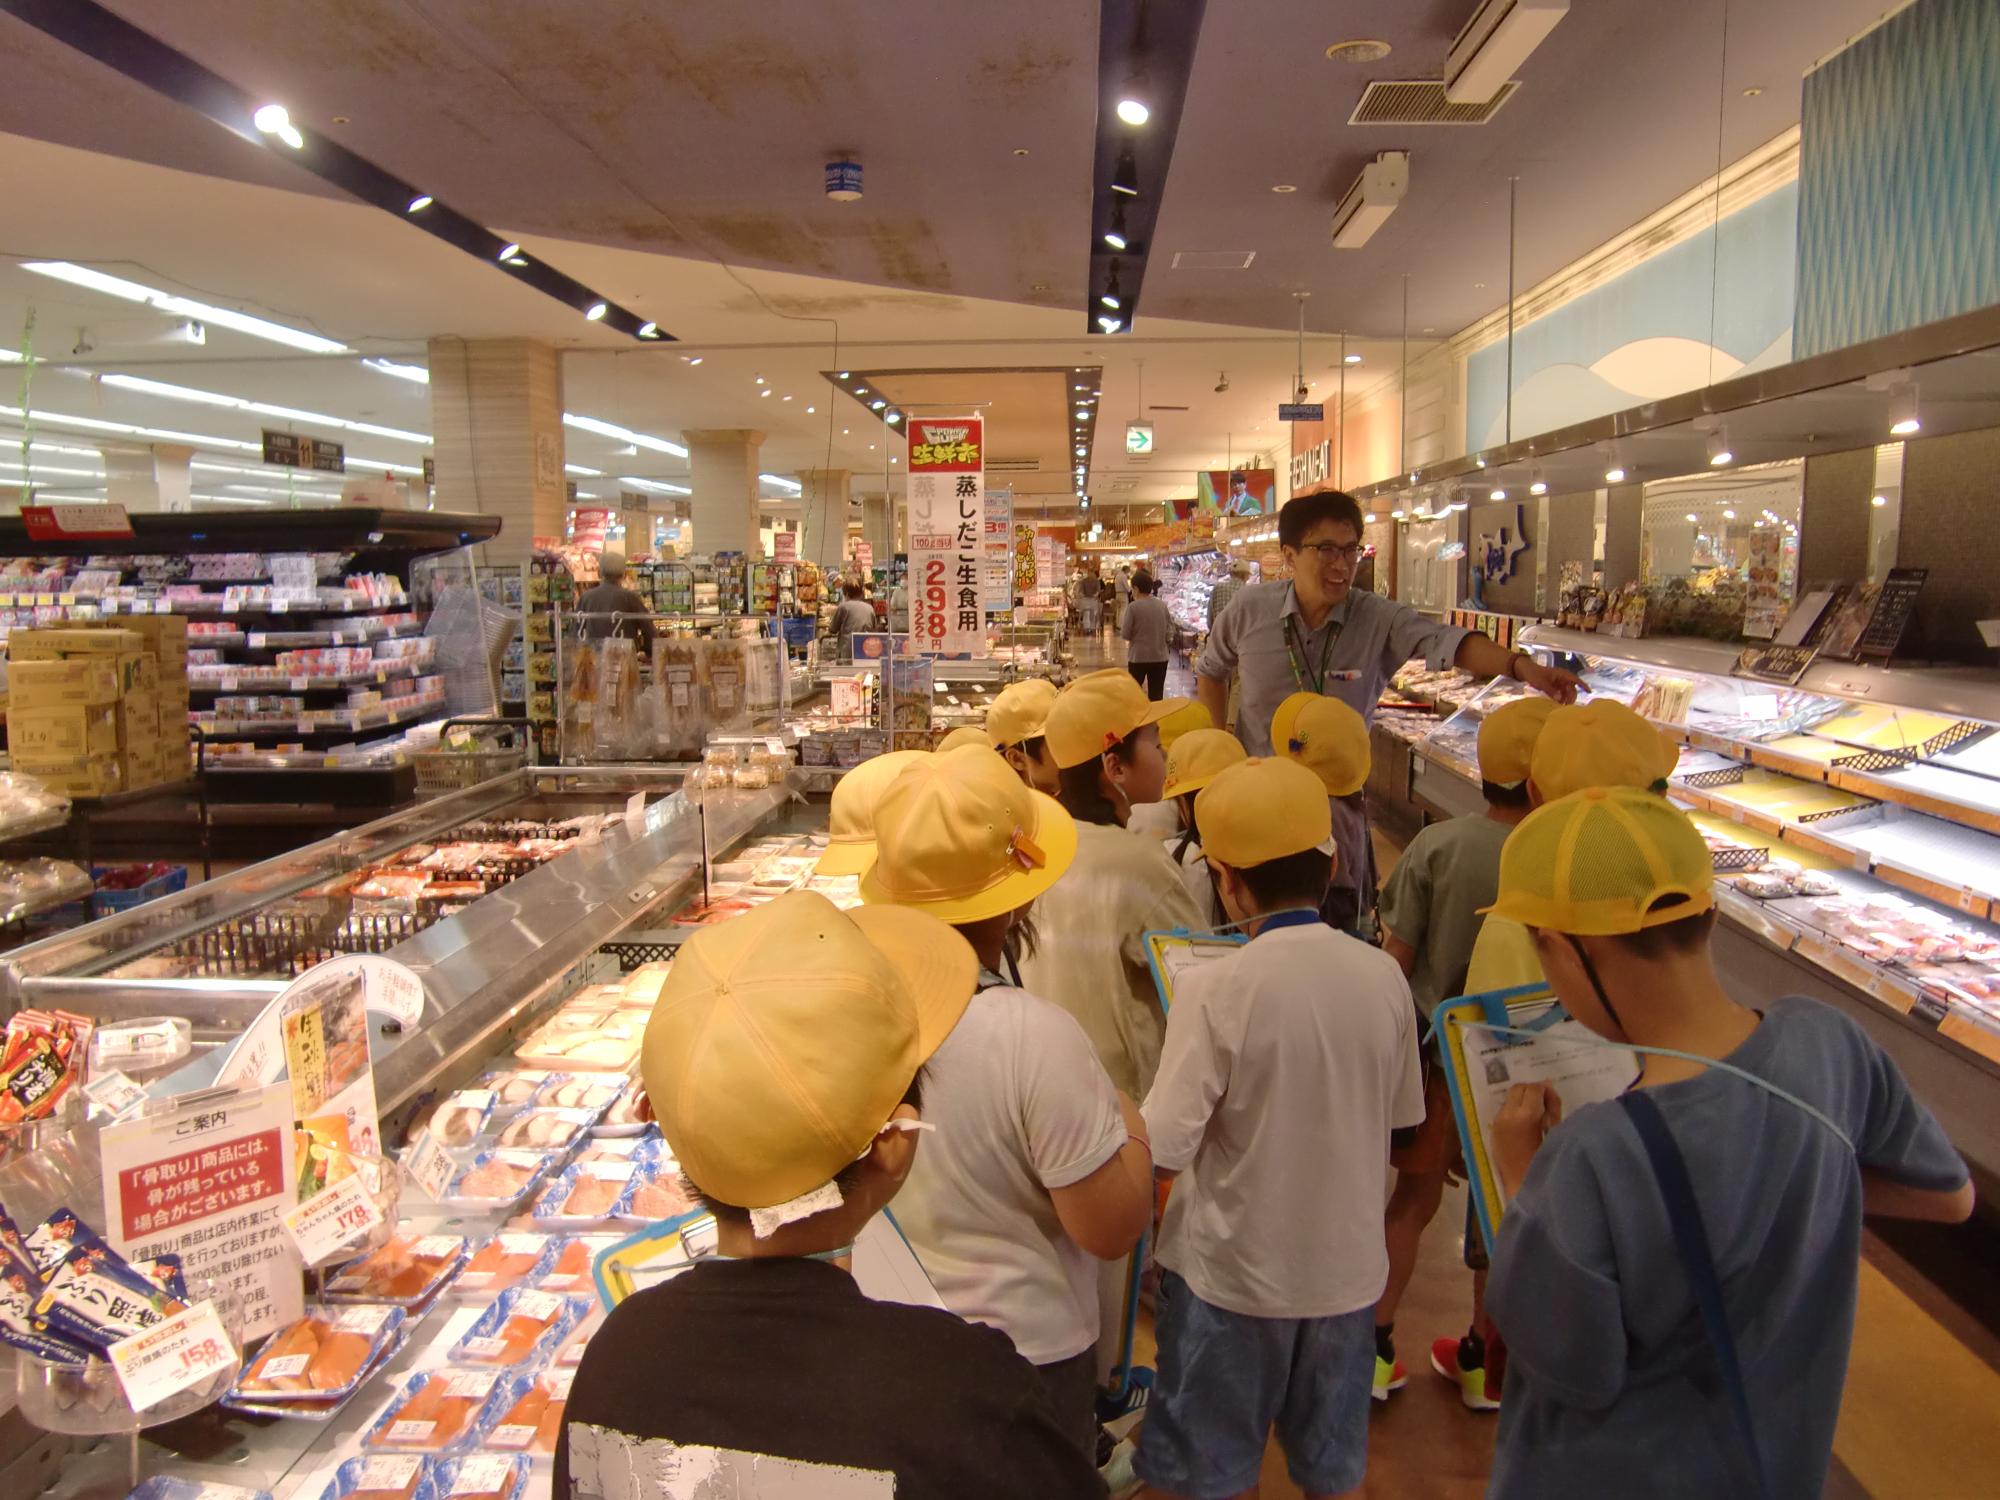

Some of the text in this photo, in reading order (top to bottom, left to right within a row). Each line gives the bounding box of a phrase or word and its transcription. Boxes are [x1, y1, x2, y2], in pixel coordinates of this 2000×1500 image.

[911, 442, 980, 465] 生鮮市
[1307, 440, 1329, 486] MEAT
[956, 475, 978, 631] 蒸しだこ生食用
[175, 1110, 227, 1136] ご案内
[131, 1139, 269, 1188] 「骨取り」商品には、
[147, 1161, 260, 1206] 骨が残っている
[134, 1180, 272, 1231] 場合がございます。
[337, 1205, 366, 1229] 178
[181, 1225, 285, 1267] を行っておりますが、
[179, 1338, 218, 1369] 158
